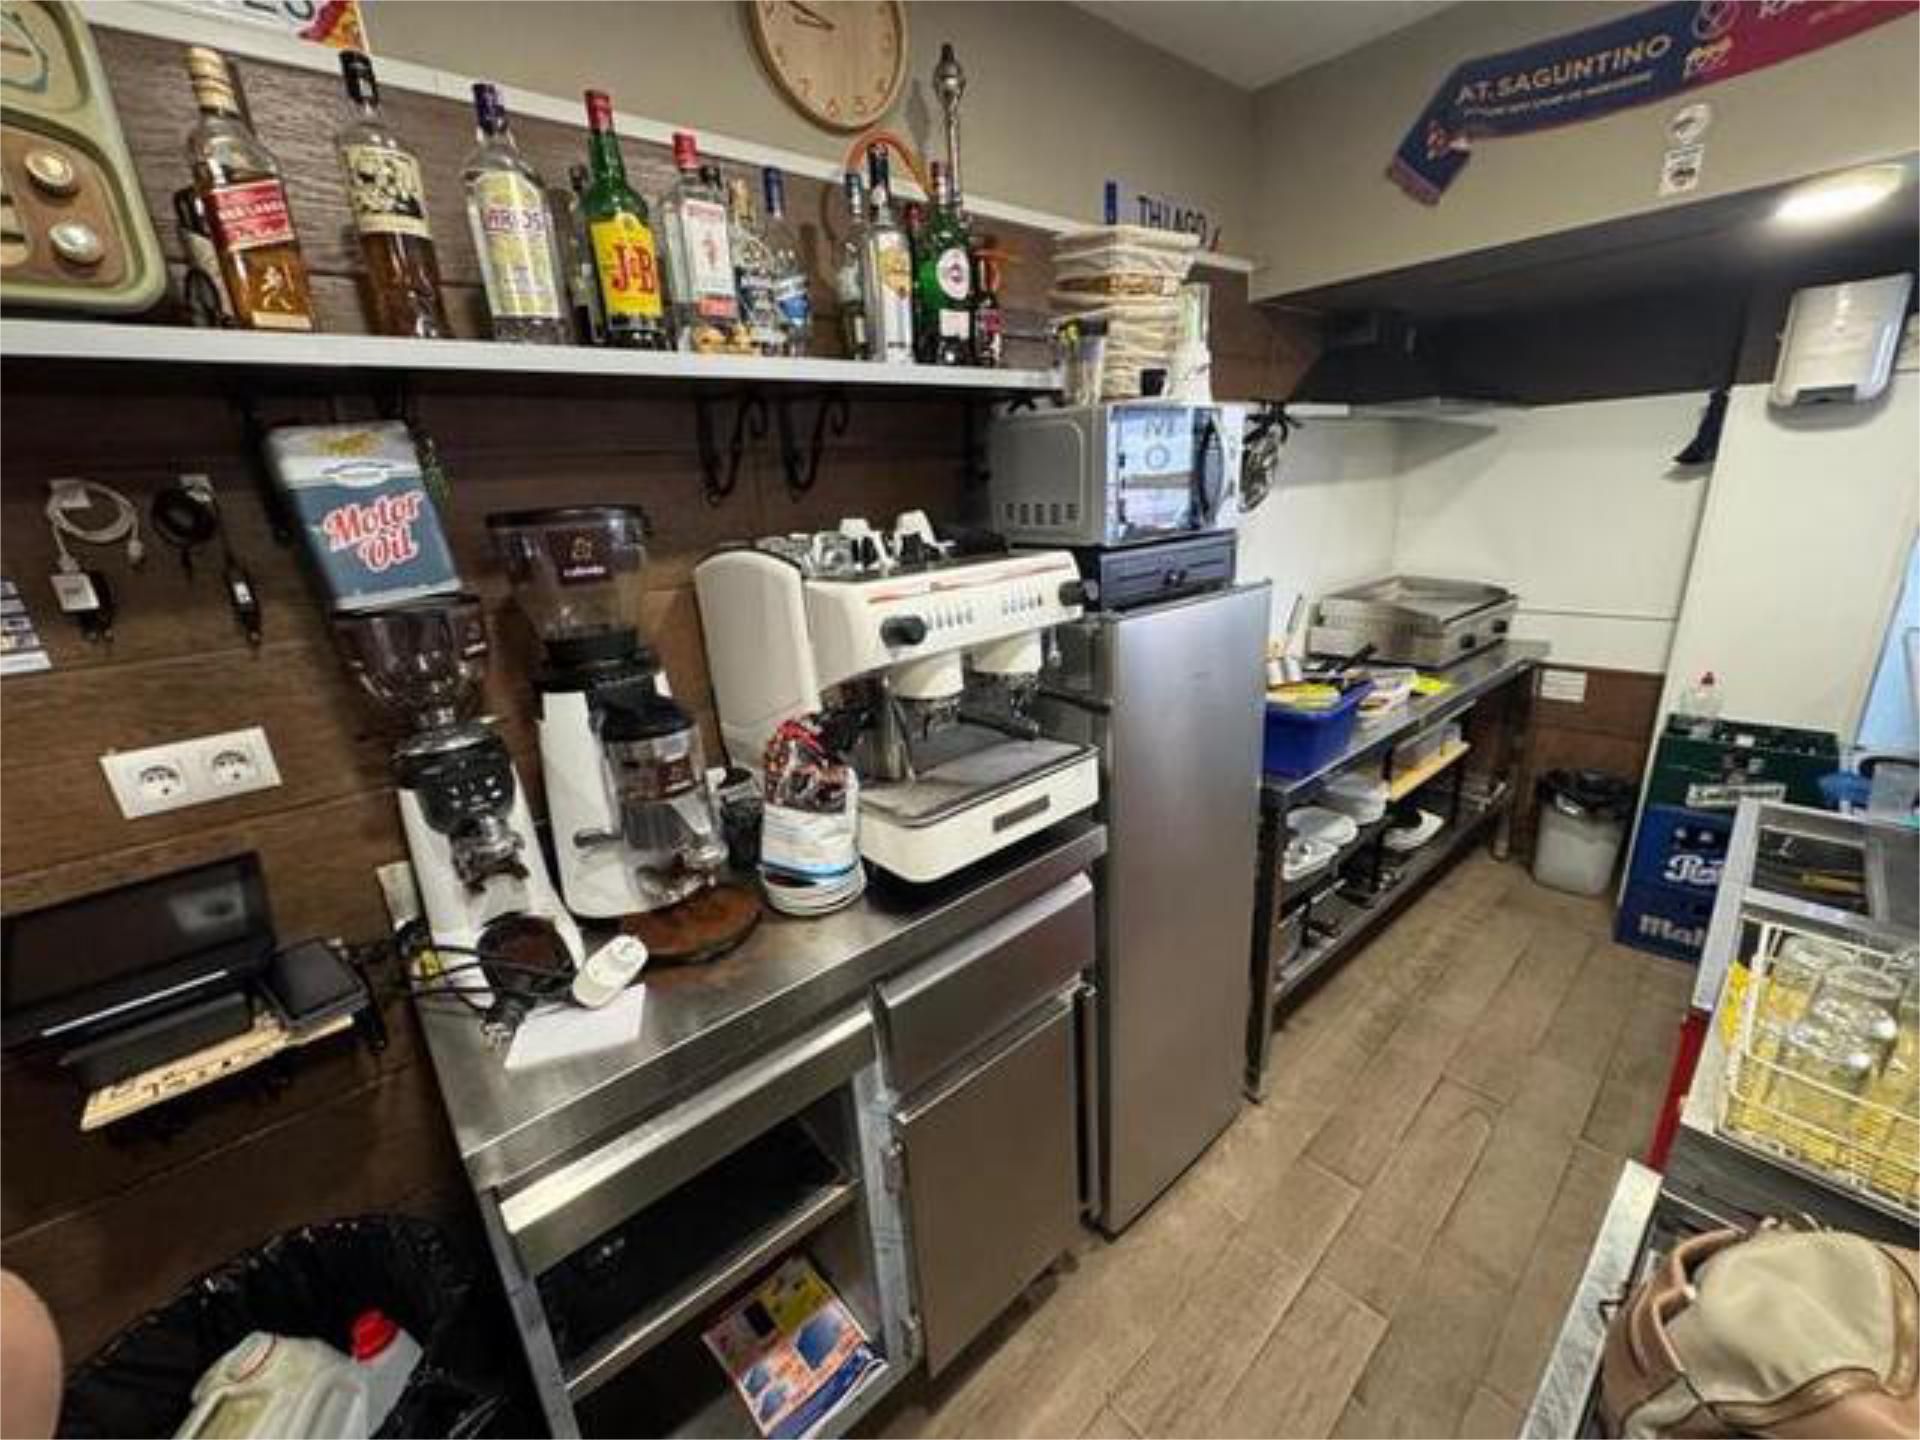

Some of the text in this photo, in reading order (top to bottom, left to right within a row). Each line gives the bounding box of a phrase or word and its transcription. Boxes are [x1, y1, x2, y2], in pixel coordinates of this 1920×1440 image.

[1495, 34, 1673, 98] SAGUNTINO
[322, 490, 424, 552] Motor
[356, 525, 420, 574] Oil
